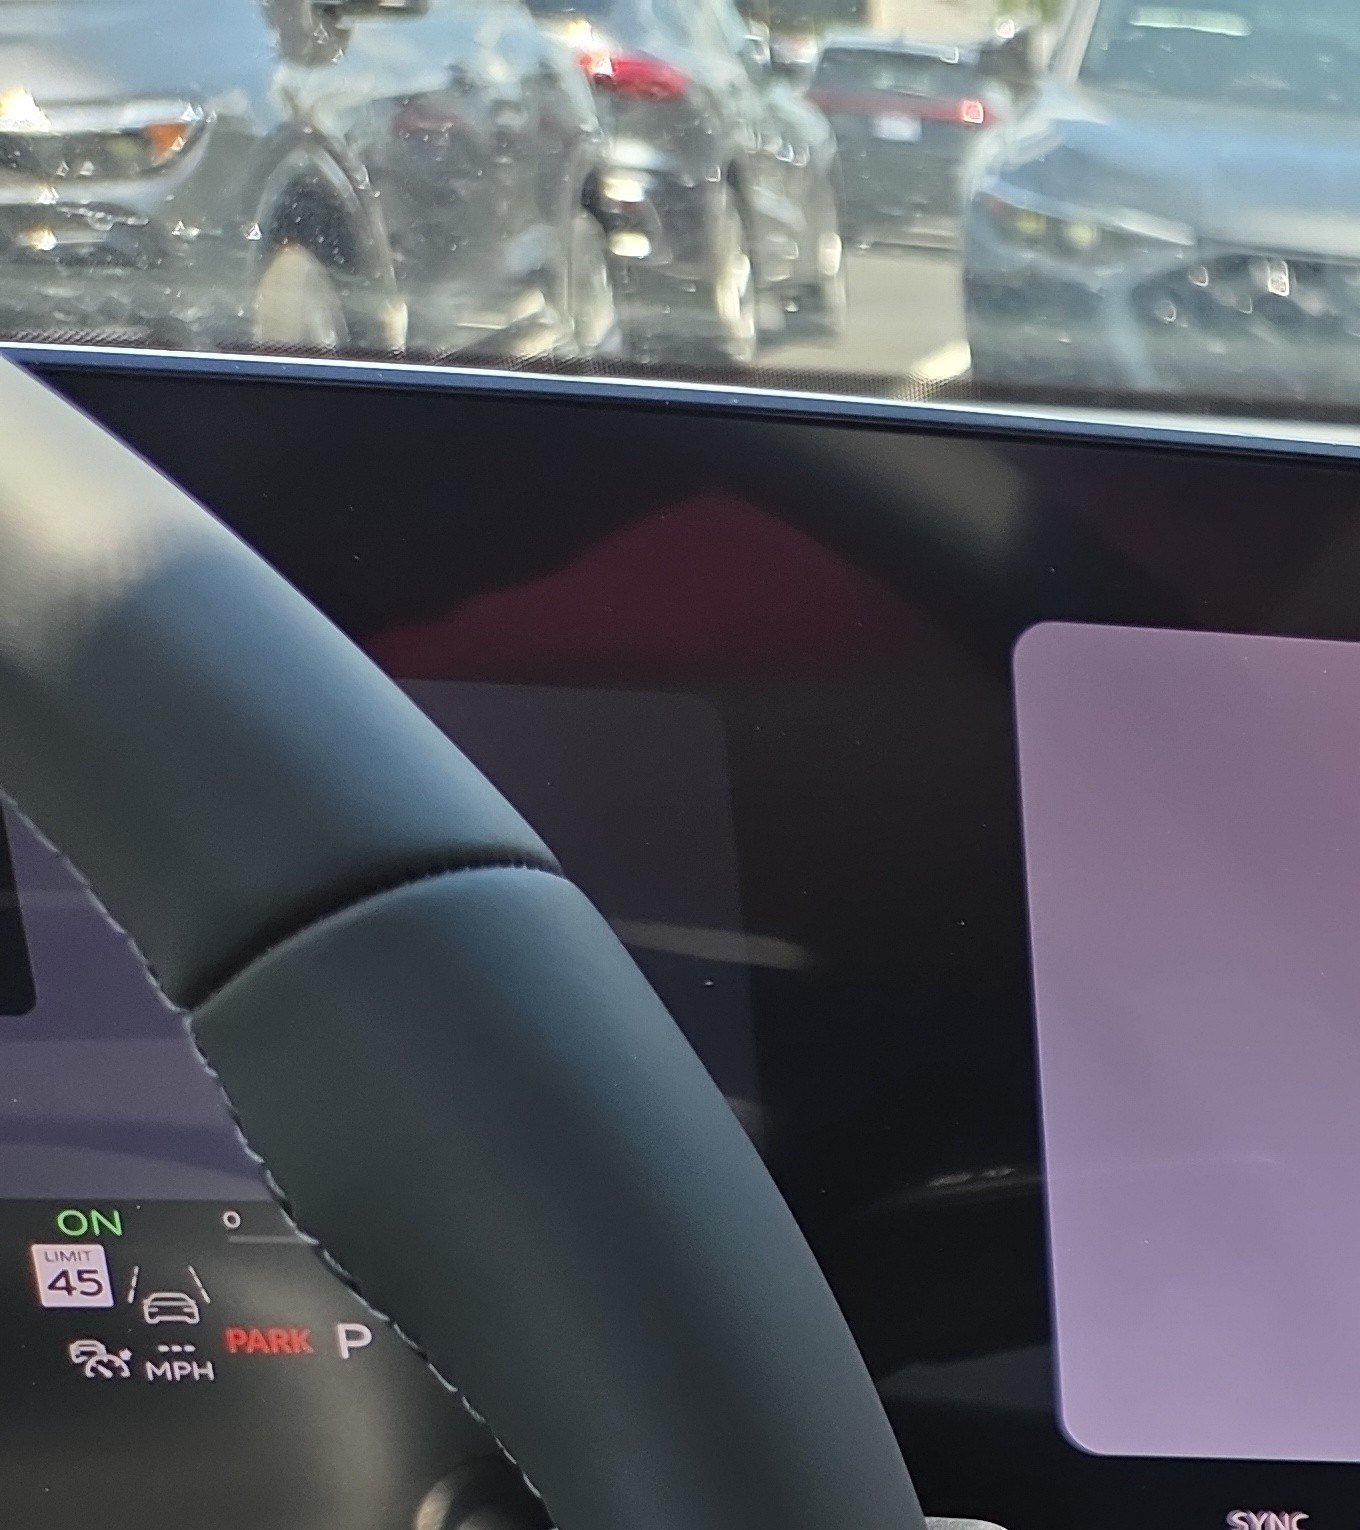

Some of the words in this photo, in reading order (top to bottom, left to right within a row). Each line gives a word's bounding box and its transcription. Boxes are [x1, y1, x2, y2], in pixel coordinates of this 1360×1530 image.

[57, 1210, 123, 1237] ON
[44, 1250, 91, 1263] LIMIT
[48, 1268, 104, 1298] 45
[226, 1327, 314, 1354] PARK
[337, 1323, 373, 1360] P
[146, 1361, 215, 1382] MPH
